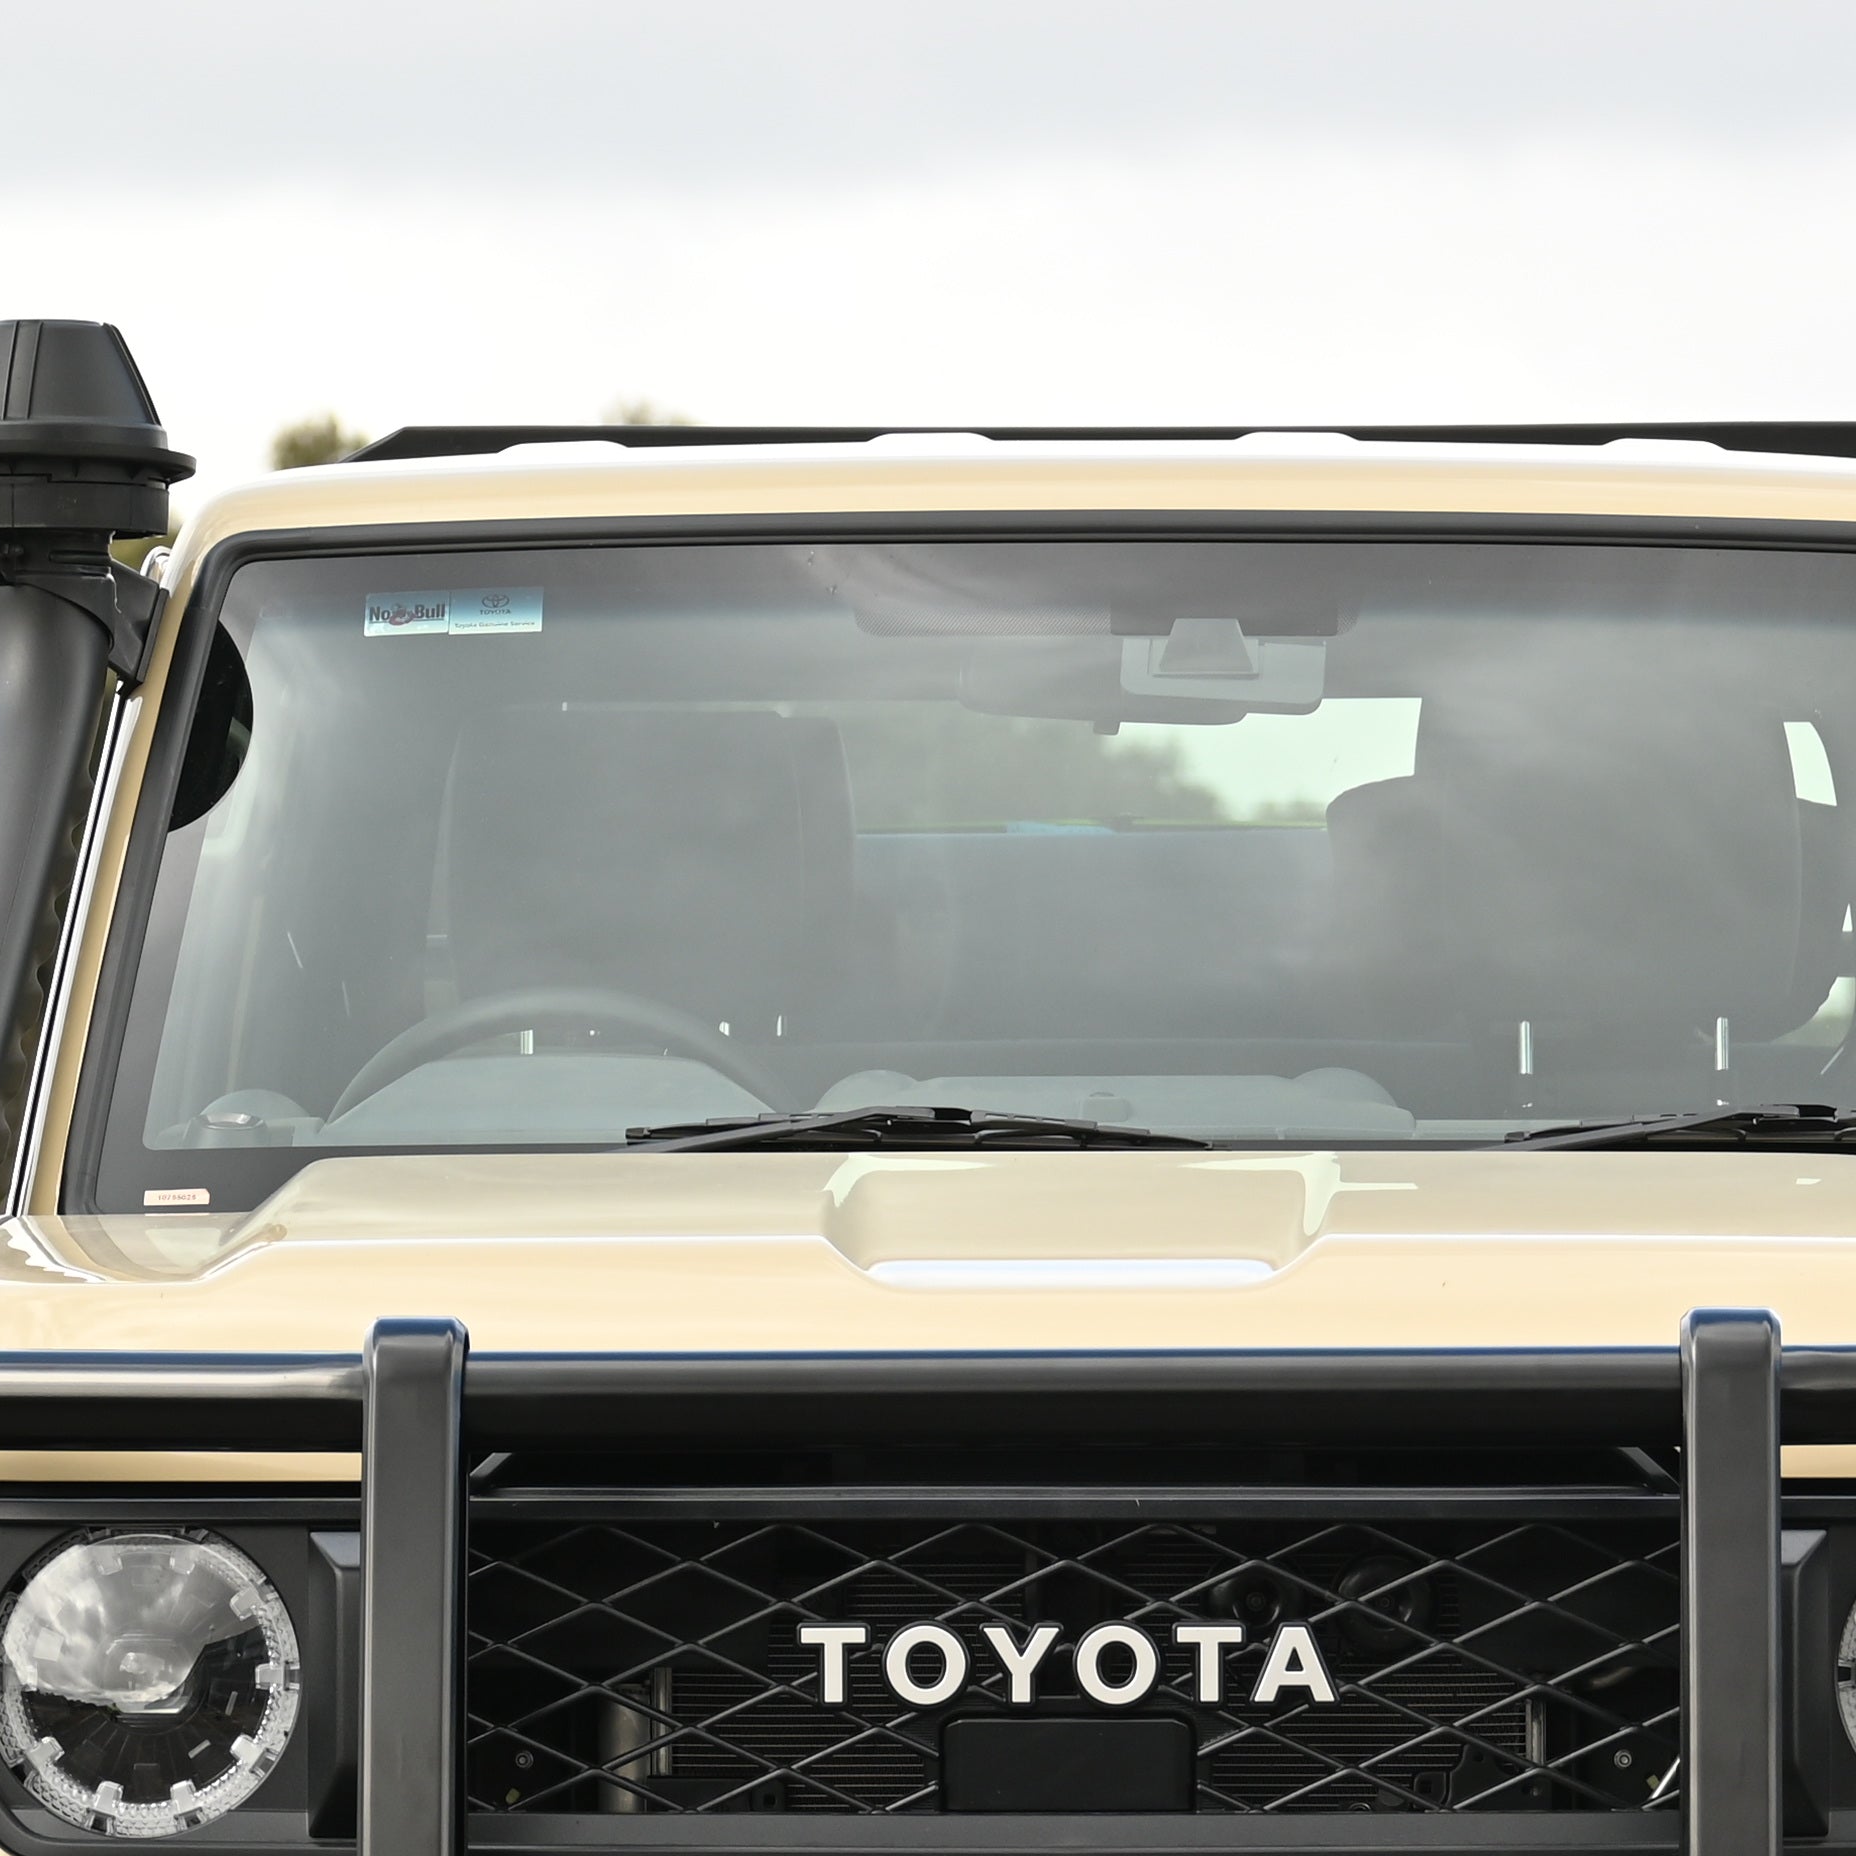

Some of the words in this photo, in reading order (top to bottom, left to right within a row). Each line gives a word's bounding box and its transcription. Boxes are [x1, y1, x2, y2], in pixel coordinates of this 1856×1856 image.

[369, 606, 390, 621] No
[414, 603, 445, 618] Bull
[800, 1625, 1337, 1704] TOYOTA
